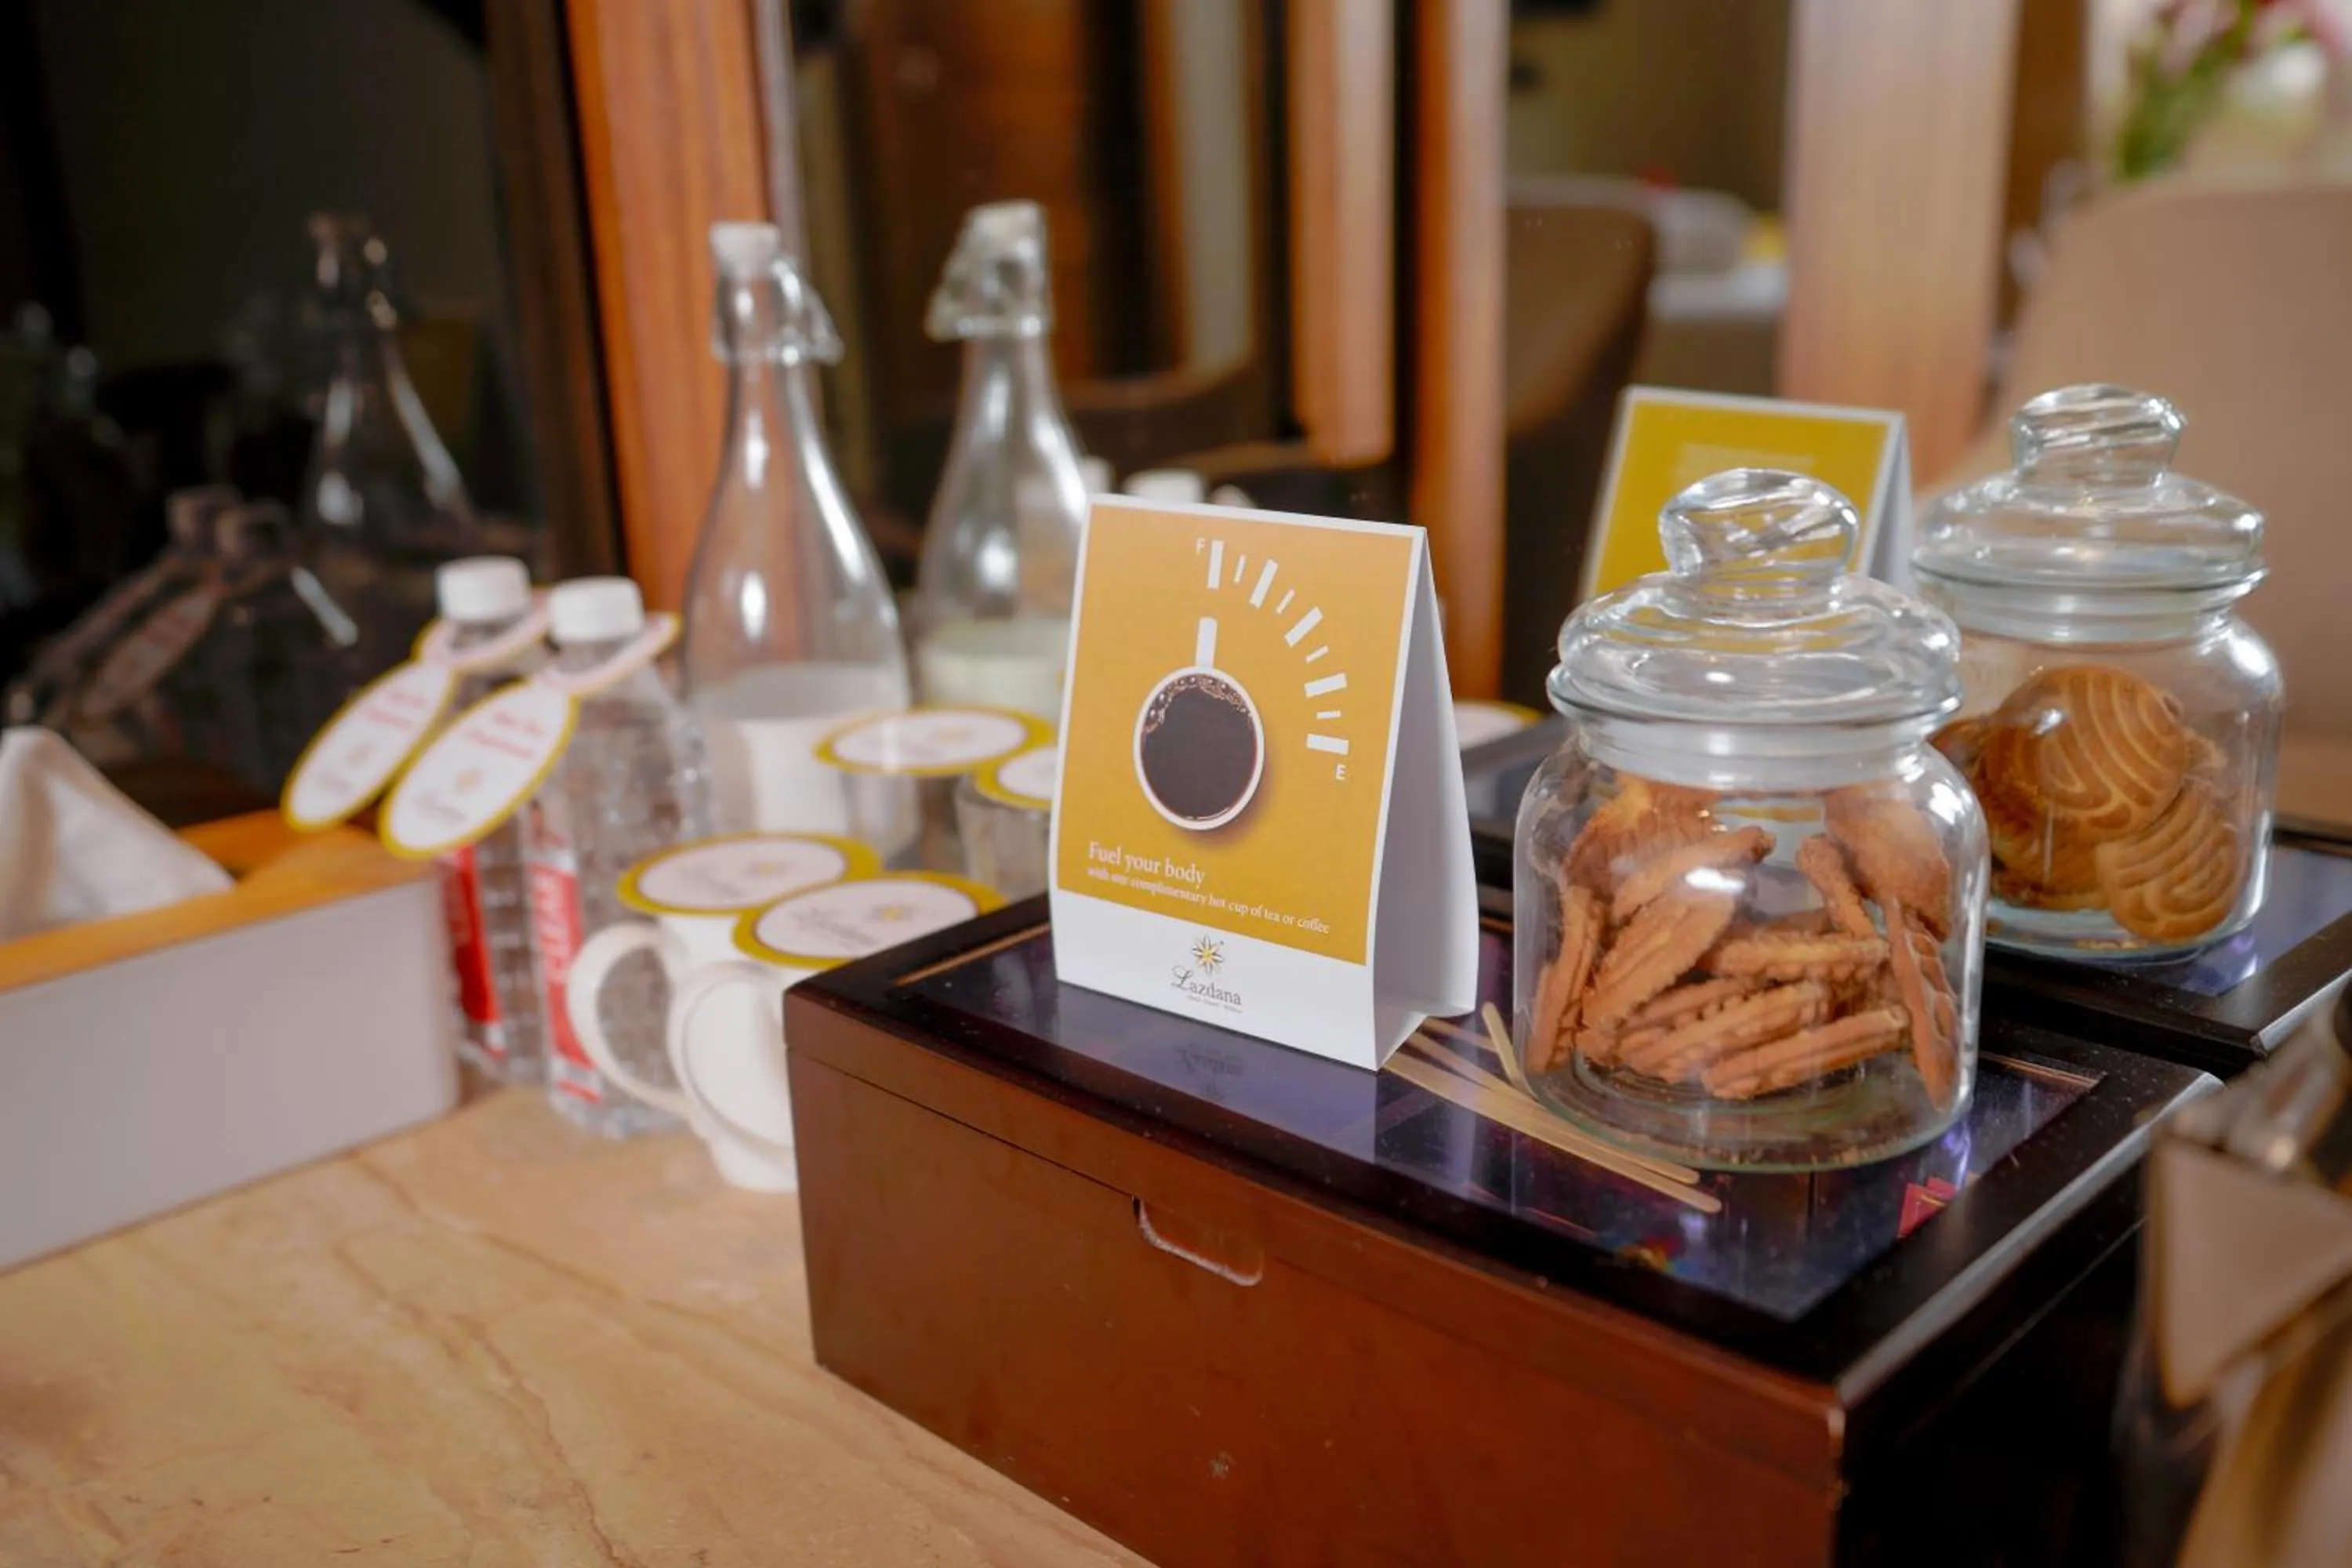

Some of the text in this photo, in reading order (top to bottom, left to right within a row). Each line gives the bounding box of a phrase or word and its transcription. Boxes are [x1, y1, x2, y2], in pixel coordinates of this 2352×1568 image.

[1196, 537, 1206, 555] F
[1335, 763, 1346, 780] E
[1088, 840, 1204, 889] Fuel your body
[1087, 867, 1330, 935] with our complimentary hot cup of tea or coffee
[1171, 964, 1242, 1005] Lazdana
